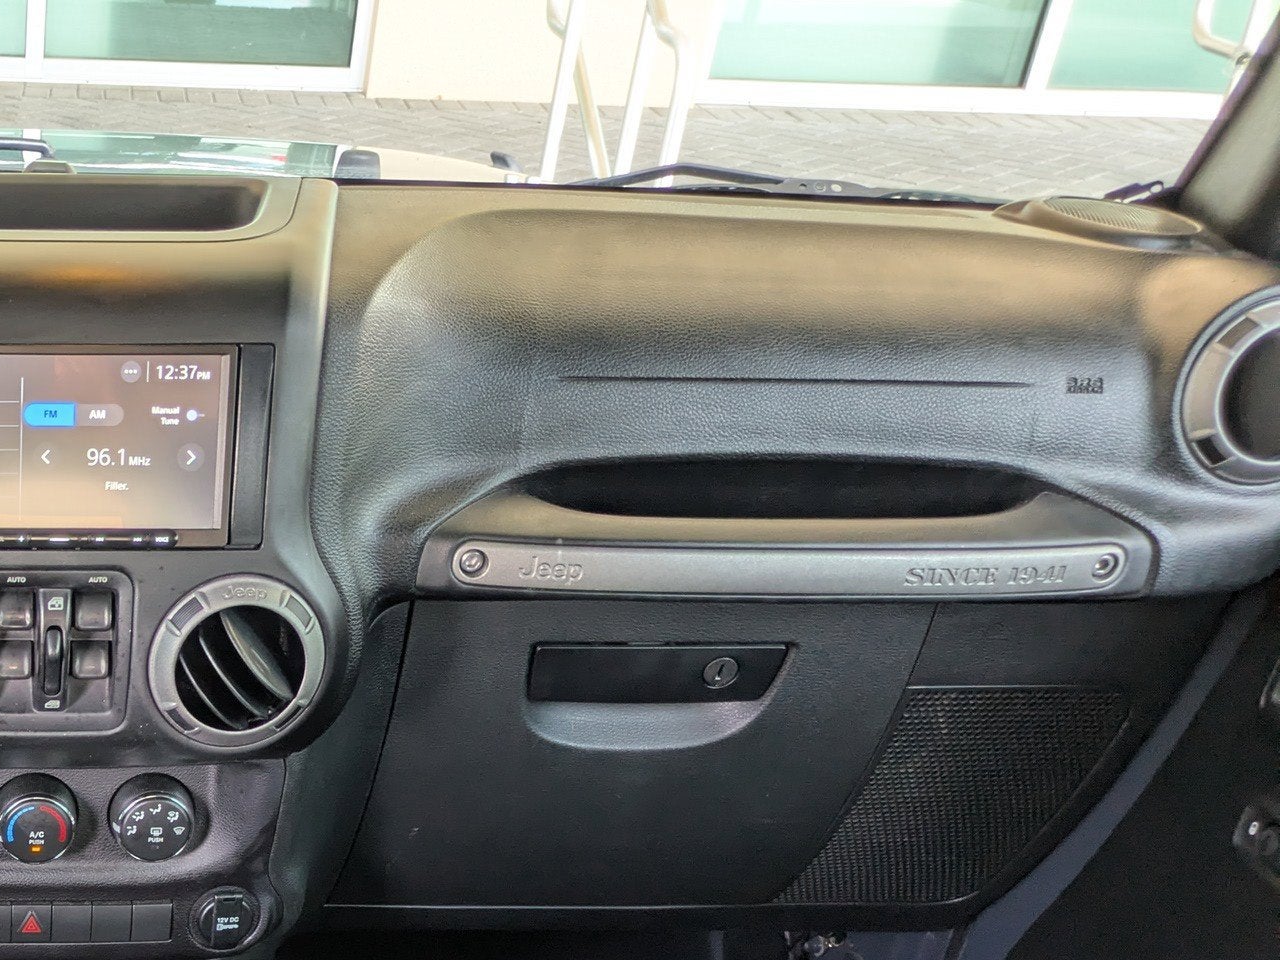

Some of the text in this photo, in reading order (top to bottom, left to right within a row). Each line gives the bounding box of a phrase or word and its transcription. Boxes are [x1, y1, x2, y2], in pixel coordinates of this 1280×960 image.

[43, 410, 58, 418] FM
[89, 409, 106, 420] AM
[151, 406, 180, 415] Manual
[161, 417, 180, 426] Tune
[86, 448, 151, 466] 96.1 MHz
[104, 481, 129, 491] Filler.
[518, 555, 584, 585] Jeep
[903, 565, 1068, 586] SINCE 1941
[221, 585, 268, 600] Jeep
